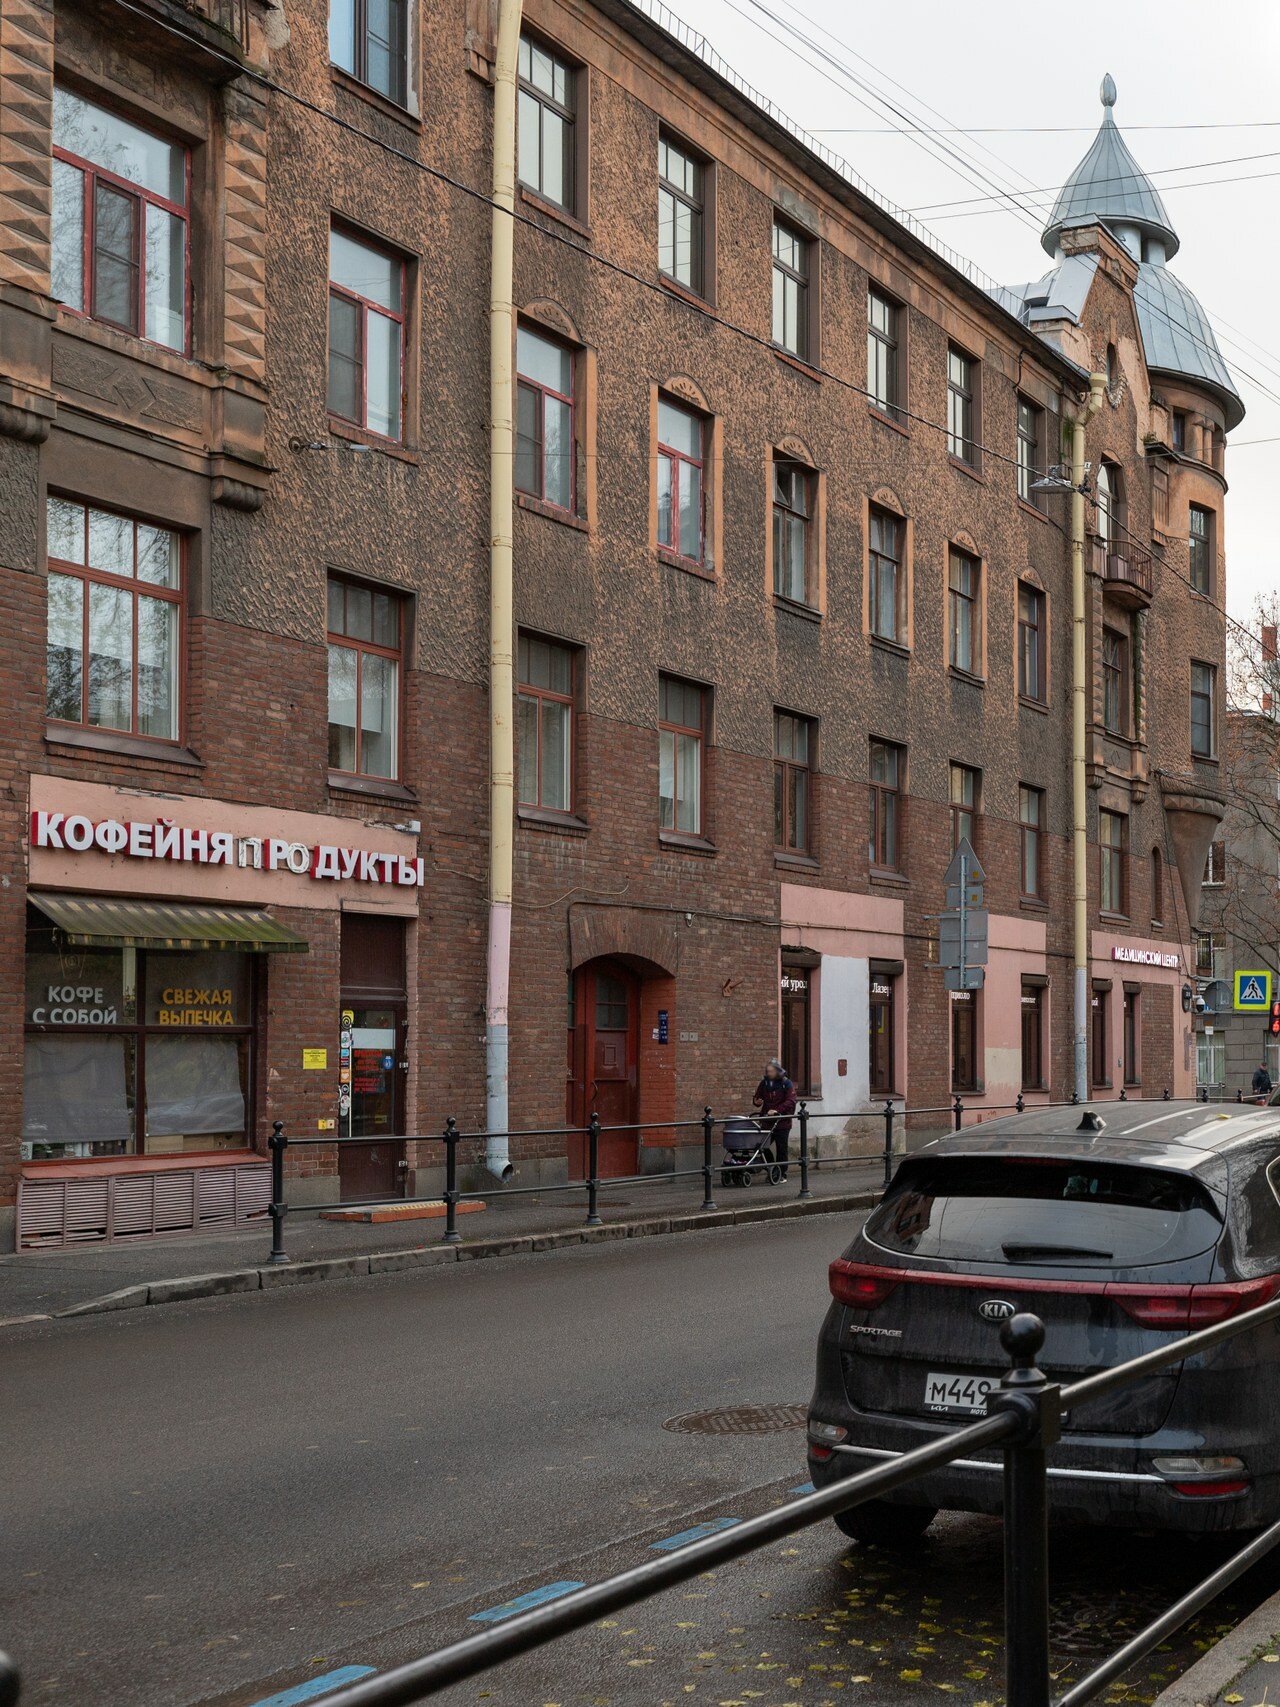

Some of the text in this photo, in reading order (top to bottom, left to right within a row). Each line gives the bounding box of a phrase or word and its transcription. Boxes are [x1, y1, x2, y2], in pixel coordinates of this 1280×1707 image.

[33, 811, 425, 887] КОФЕЙНЯ ПРОДУКТЫ
[1113, 946, 1179, 968] МЕДИЦИНСКИЙ ЦЕНТР
[48, 985, 104, 1004] КОФЕ
[162, 988, 233, 1006] СВЕЖАЯ
[32, 1006, 117, 1025] С СОБОЙ
[159, 1009, 235, 1025] ВЫПЕЧКА
[984, 1303, 1009, 1318] KIA
[849, 1324, 903, 1338] SPORTAGE
